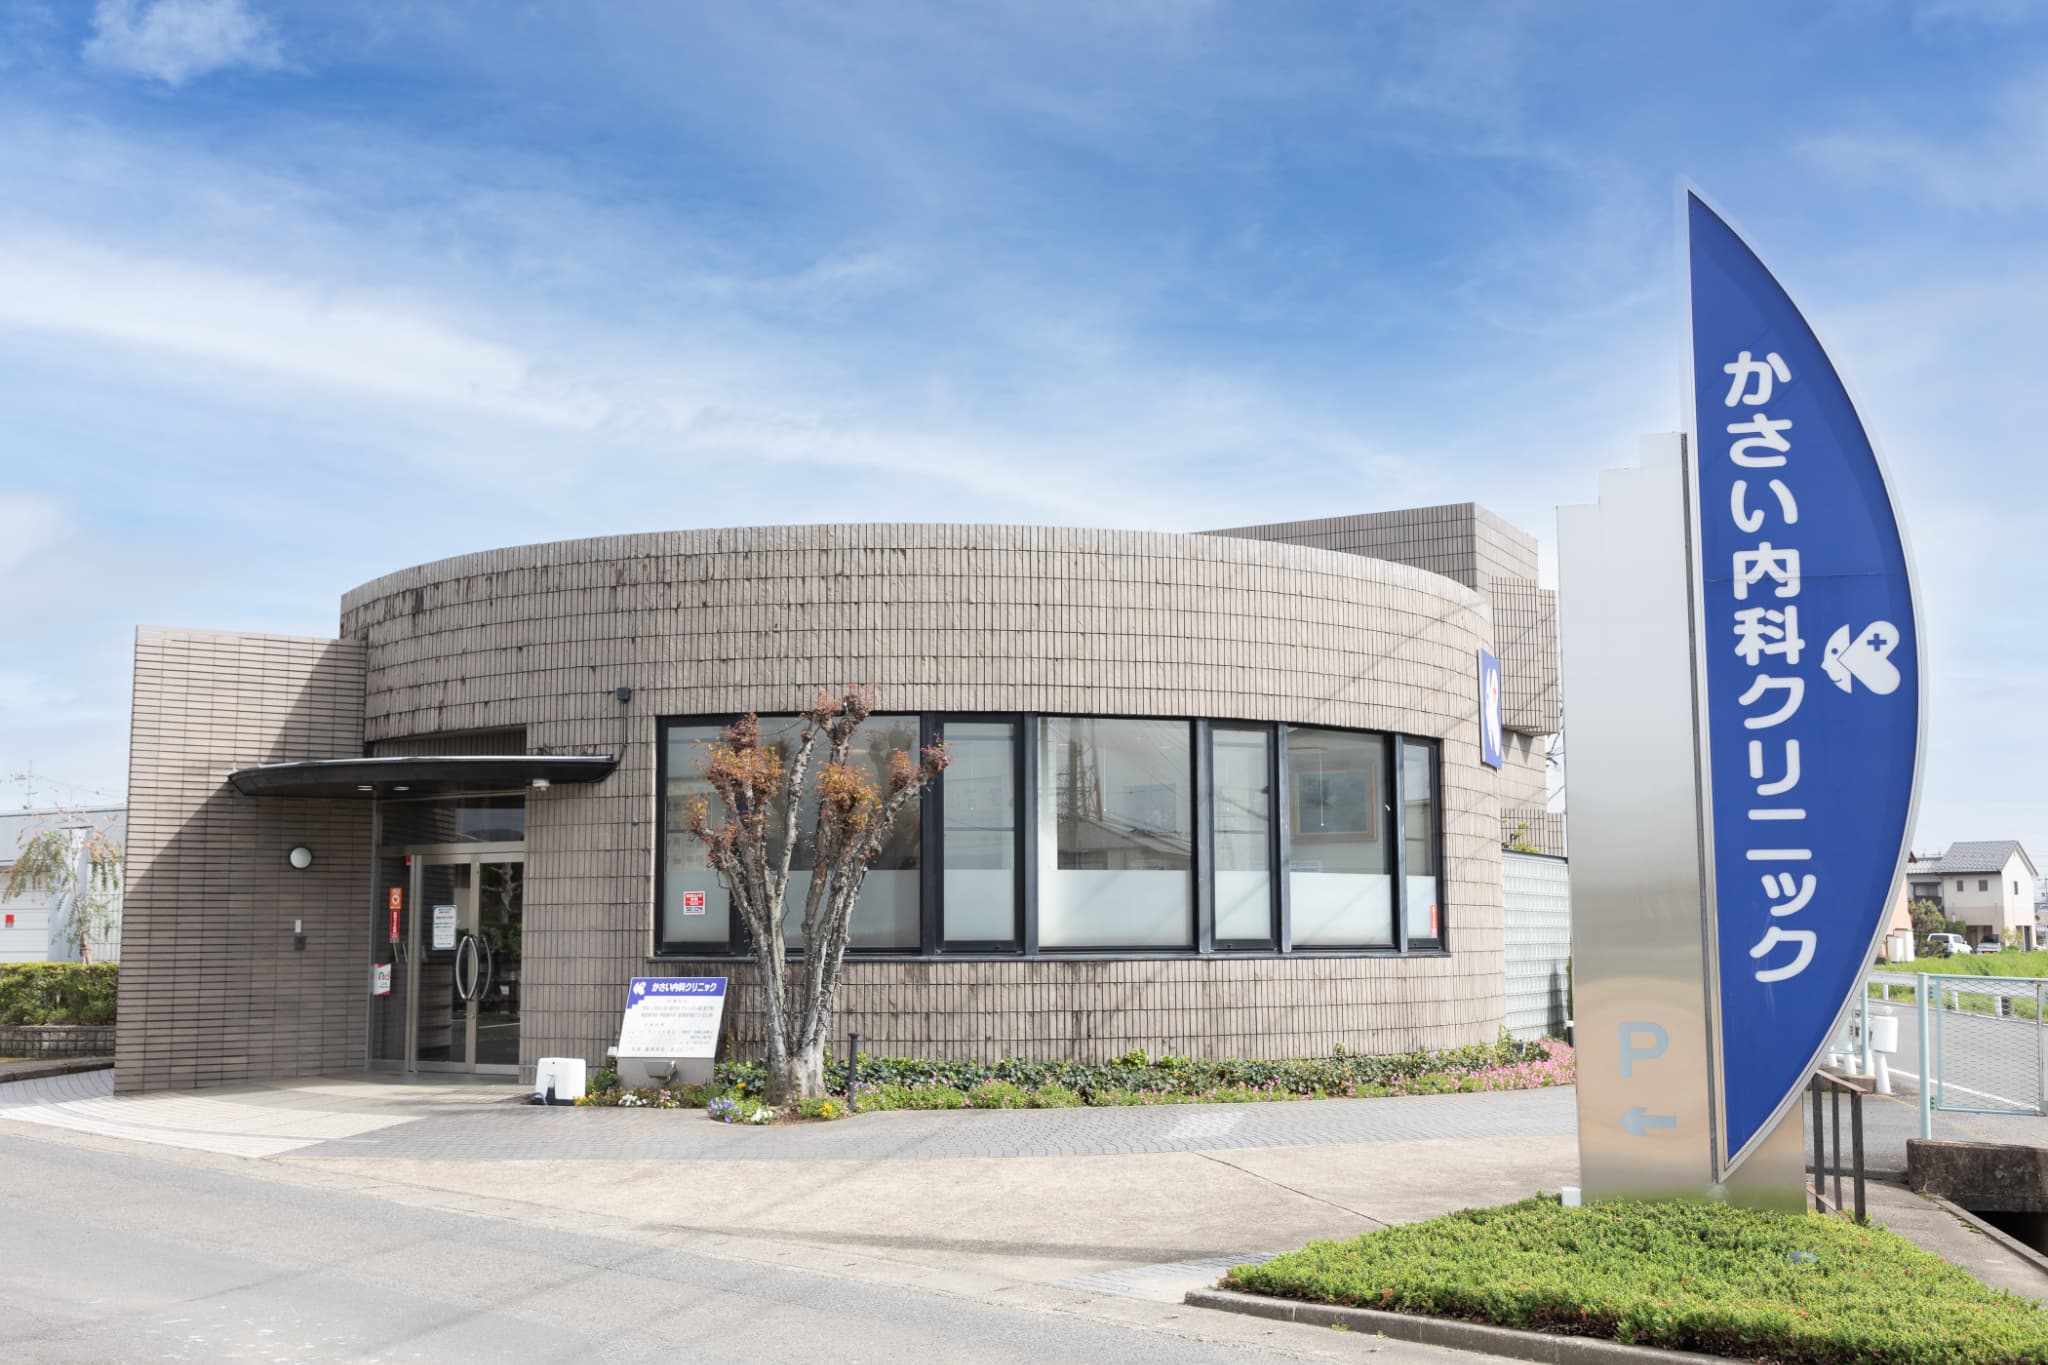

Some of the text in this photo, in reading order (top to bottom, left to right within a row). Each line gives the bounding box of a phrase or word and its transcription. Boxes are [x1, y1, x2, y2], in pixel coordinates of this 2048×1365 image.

[1723, 350, 1817, 983] かさい内科クリニック
[651, 982, 717, 992] かさい内科クリニック
[1618, 1022, 1669, 1078] P
